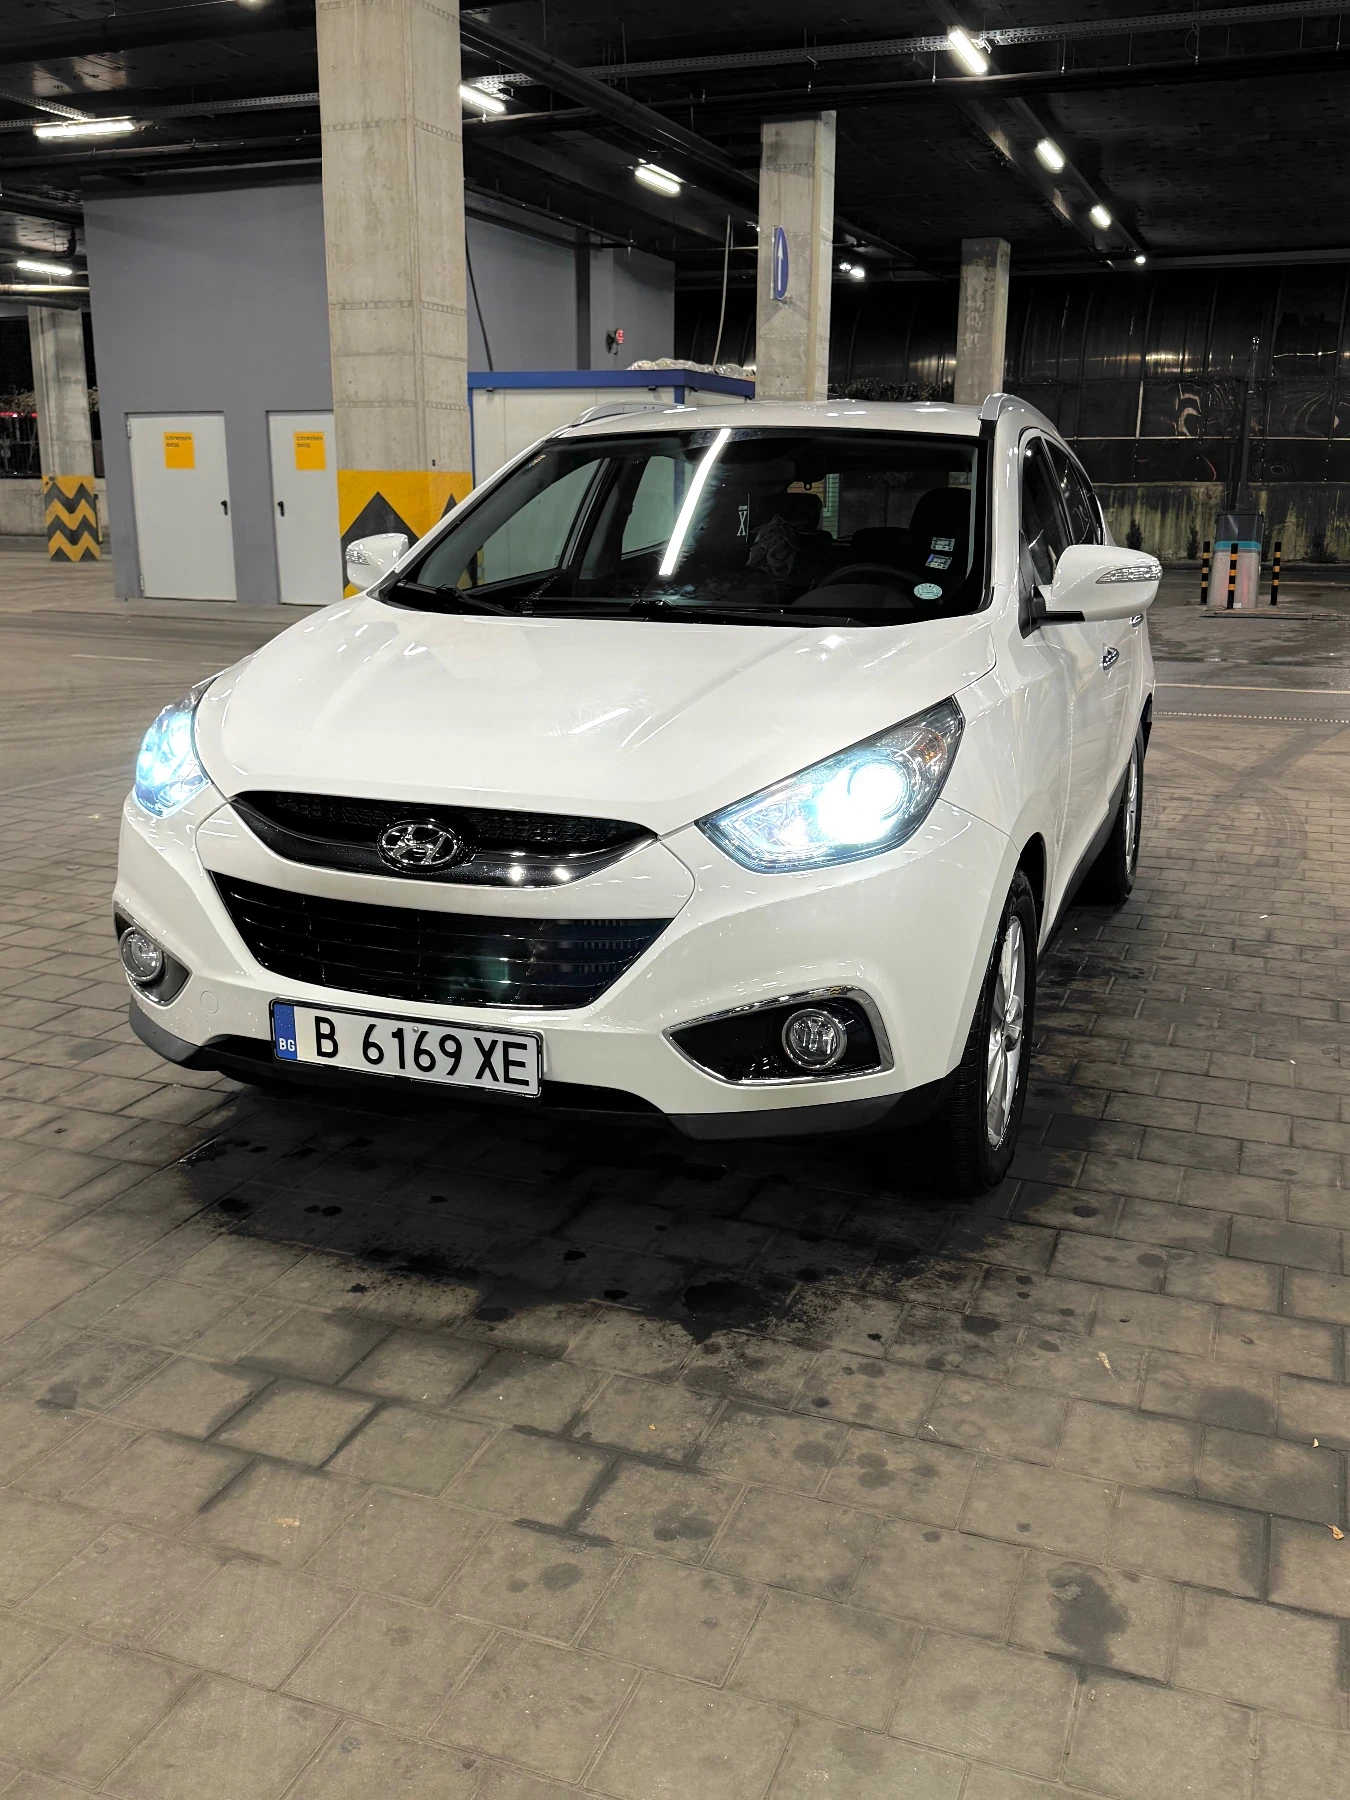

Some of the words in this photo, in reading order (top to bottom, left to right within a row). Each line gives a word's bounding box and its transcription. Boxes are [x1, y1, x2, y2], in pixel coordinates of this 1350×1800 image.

[278, 1037, 296, 1052] BG
[314, 1015, 339, 1059] B
[362, 1023, 463, 1076] 6169
[473, 1036, 530, 1087] XE
